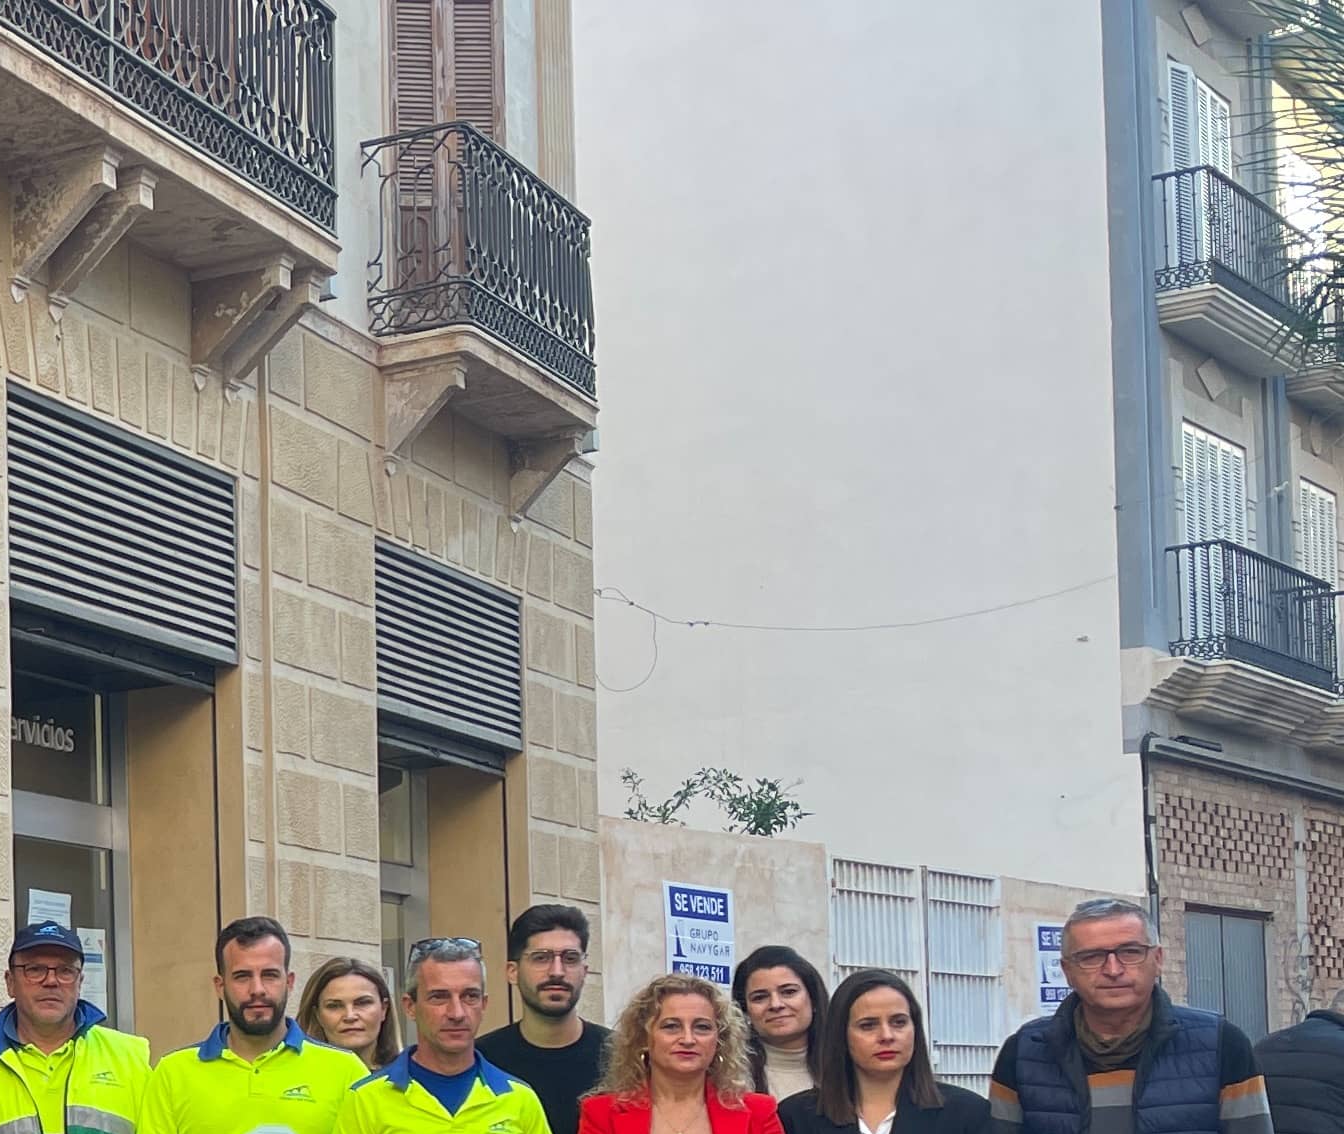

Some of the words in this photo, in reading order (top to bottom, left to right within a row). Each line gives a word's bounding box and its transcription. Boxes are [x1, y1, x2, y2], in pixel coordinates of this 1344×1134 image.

[11, 715, 75, 752] ervicios
[674, 892, 689, 912] SE
[689, 894, 725, 916] VENDE
[690, 928, 719, 941] GRUPO
[711, 966, 724, 982] 511
